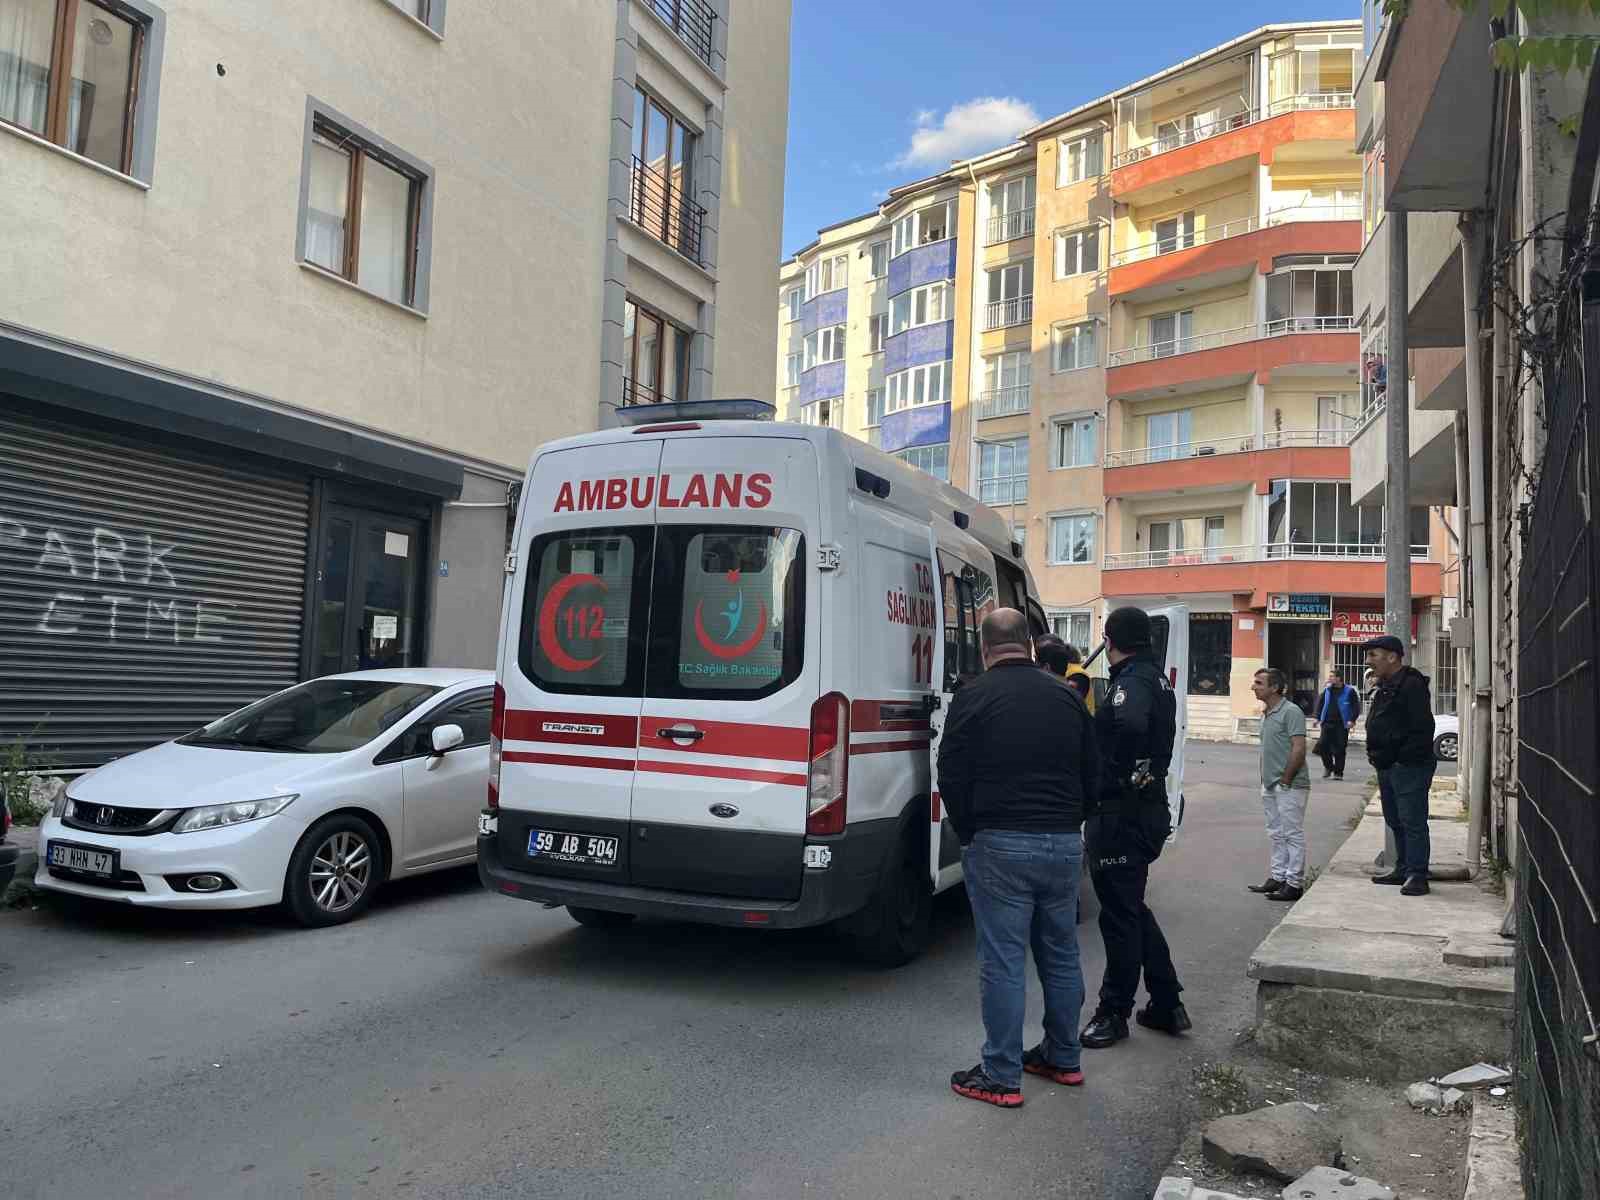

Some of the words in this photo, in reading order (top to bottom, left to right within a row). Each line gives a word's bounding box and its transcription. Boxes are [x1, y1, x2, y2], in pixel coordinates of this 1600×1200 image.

[553, 473, 772, 512] AMBULANS
[36, 592, 238, 645] ETME
[887, 586, 918, 628] SAĞLIK
[1359, 612, 1385, 623] KUR
[566, 604, 604, 640] 112
[695, 663, 728, 677] Sağlık
[543, 722, 604, 736] TRANSIT
[54, 847, 65, 864] 33
[95, 854, 108, 871] 47
[536, 832, 554, 851] 59
[560, 835, 579, 854] AB
[587, 837, 614, 859] 504
